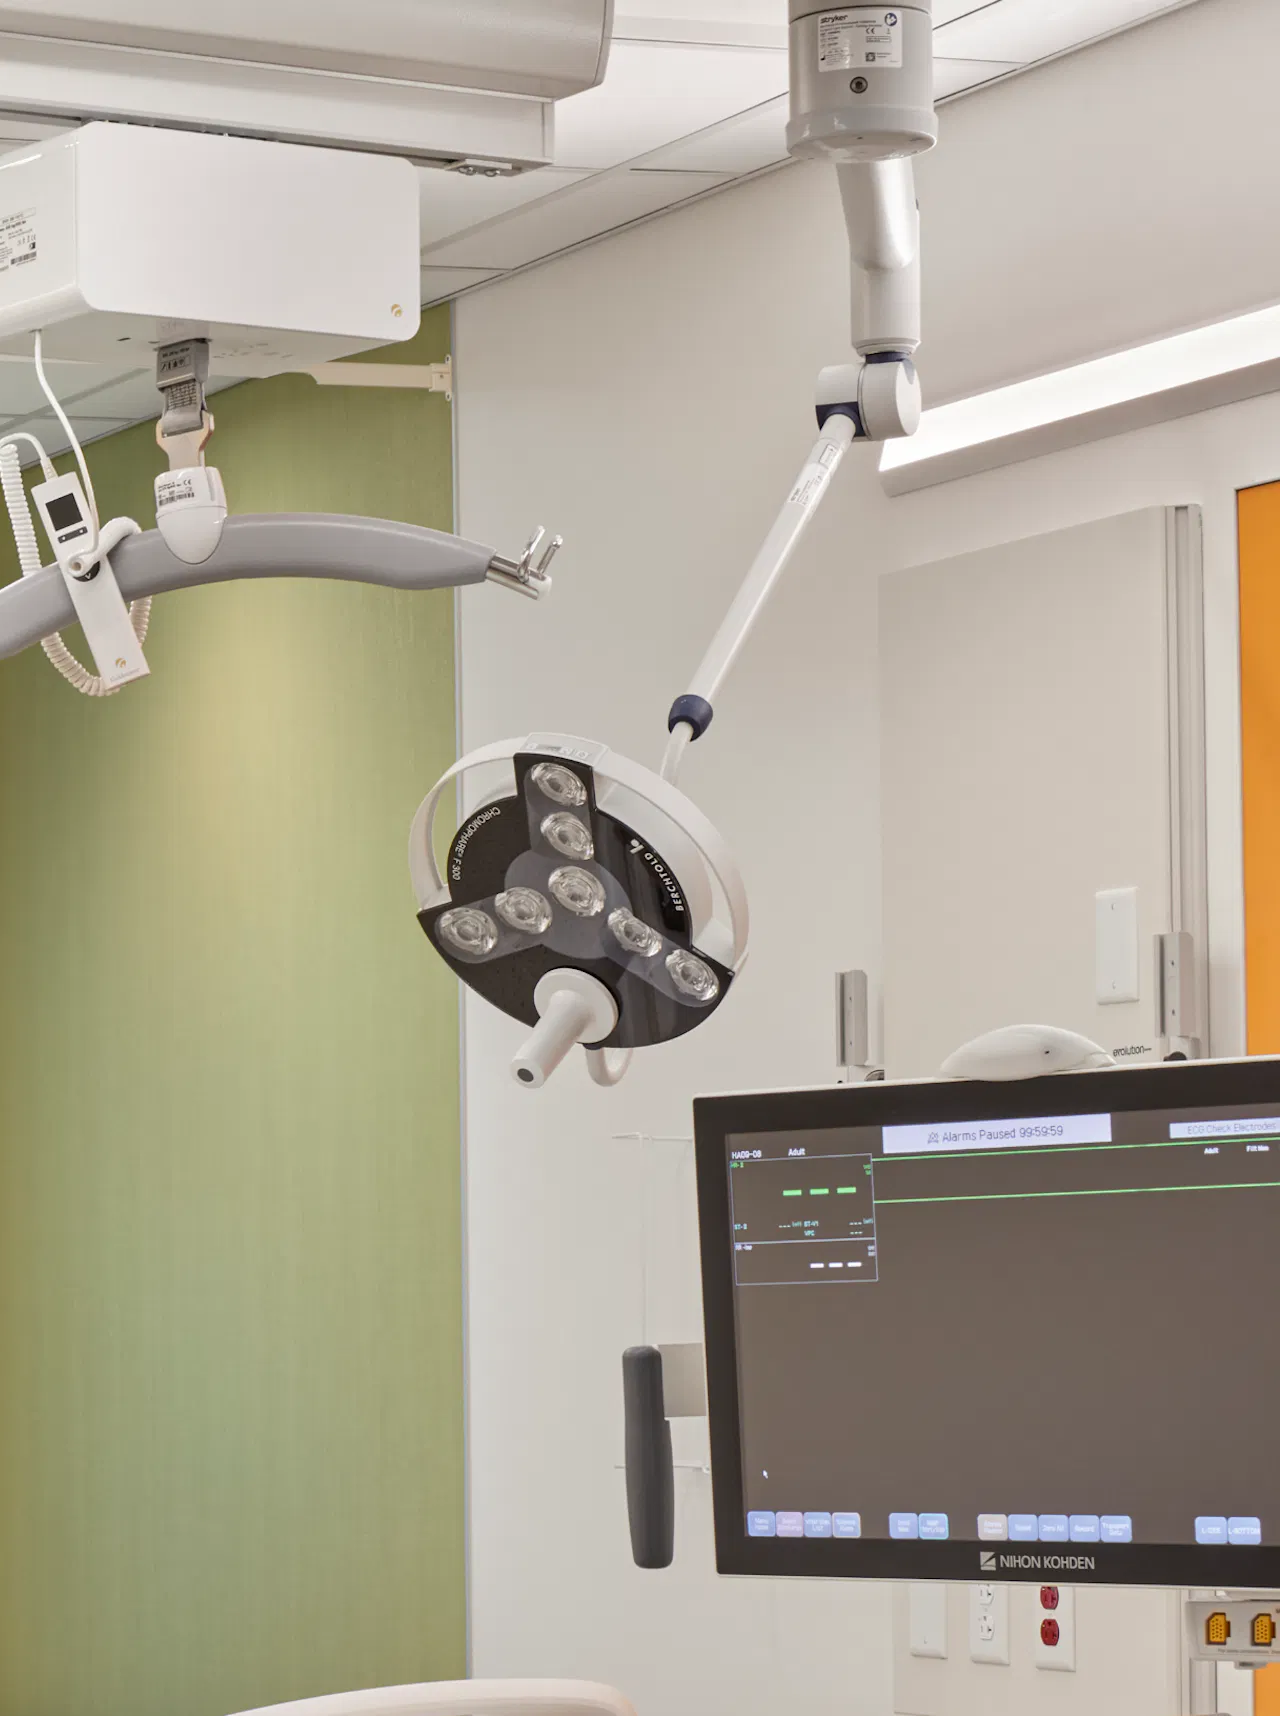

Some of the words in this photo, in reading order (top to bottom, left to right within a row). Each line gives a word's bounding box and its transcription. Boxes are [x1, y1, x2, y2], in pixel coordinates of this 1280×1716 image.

[820, 14, 848, 24] stryker
[452, 865, 462, 881] 300
[644, 852, 685, 912] BERCHTOLD
[942, 1131, 977, 1143] Alarms
[979, 1128, 1016, 1141] Paused
[1019, 1125, 1064, 1138] 99:59:59
[1187, 1126, 1205, 1135] ECG
[1206, 1124, 1232, 1133] Check
[1233, 1122, 1277, 1132] Electrodes
[788, 1147, 806, 1156] Adult
[999, 1554, 1041, 1569] NIHON
[1043, 1555, 1095, 1570] KOHDEN
